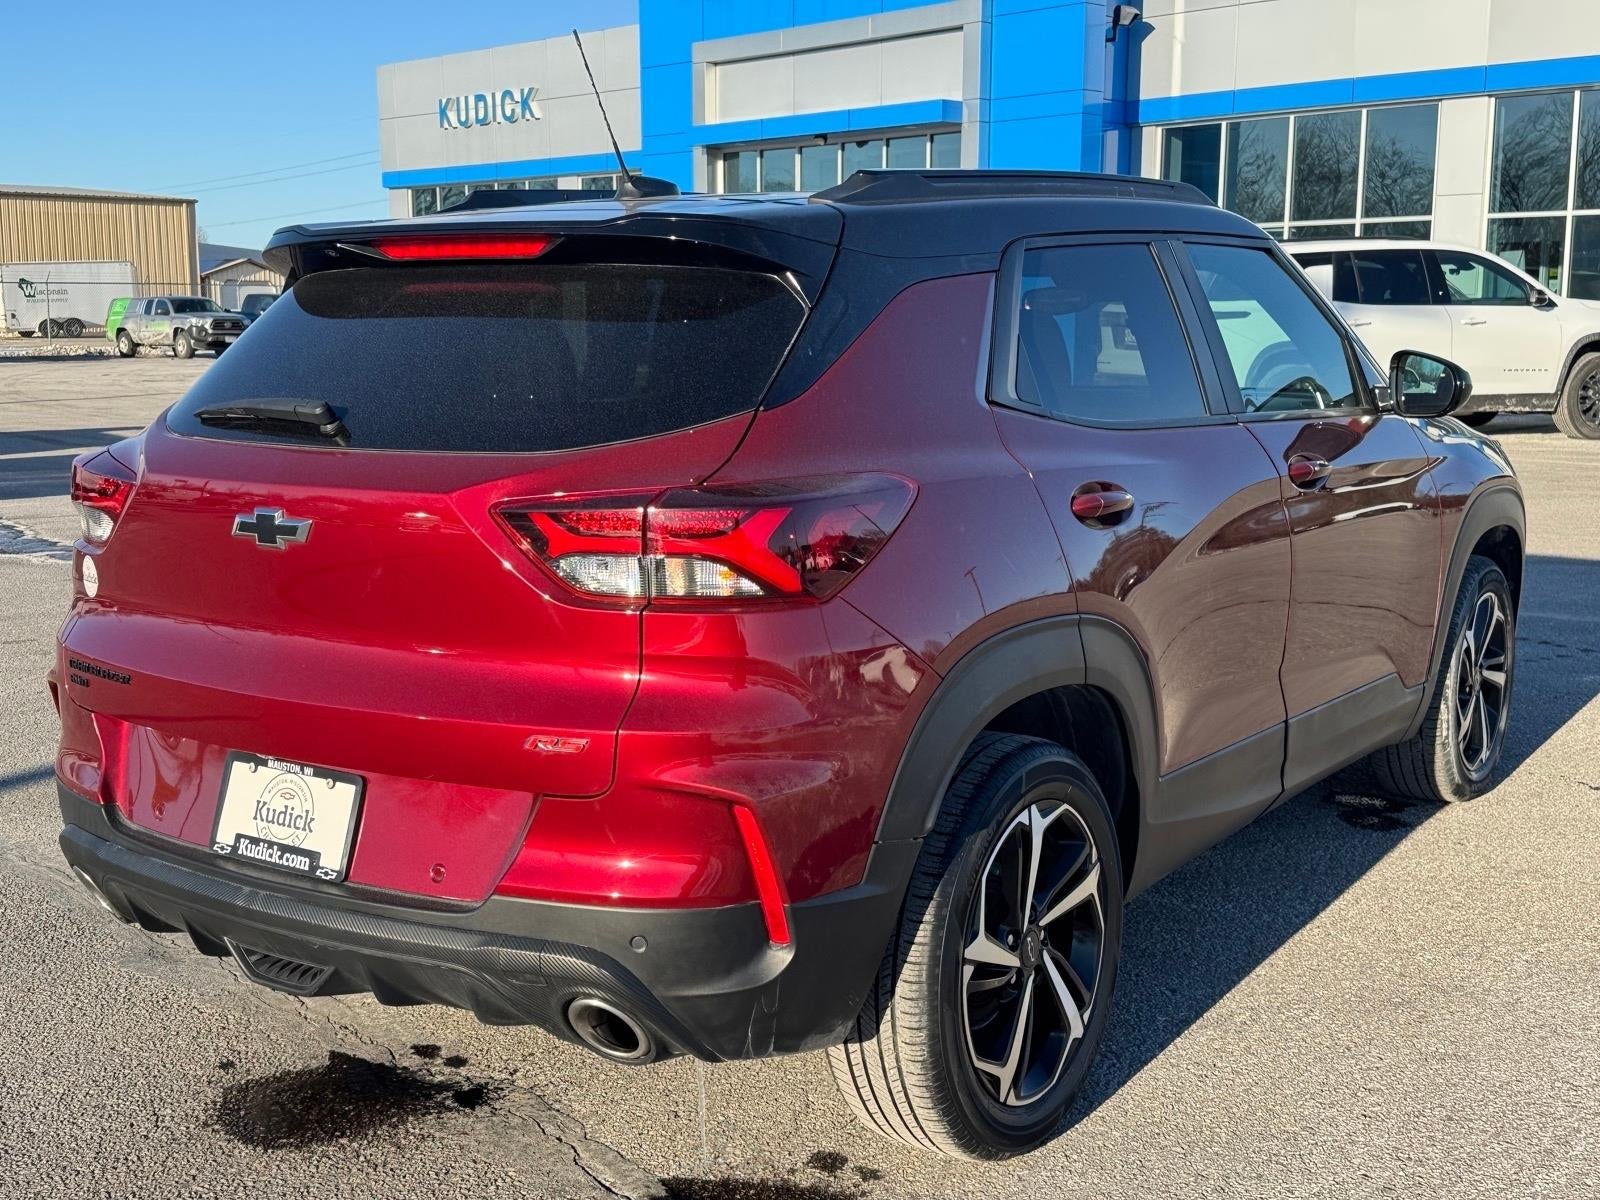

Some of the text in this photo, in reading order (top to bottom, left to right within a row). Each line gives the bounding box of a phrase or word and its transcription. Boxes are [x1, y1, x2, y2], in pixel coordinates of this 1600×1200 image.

[438, 87, 538, 129] KUDICK
[524, 735, 590, 753] RS
[303, 766, 314, 777] WI
[252, 799, 316, 834] Kudick
[237, 837, 310, 871] Kudick.com
